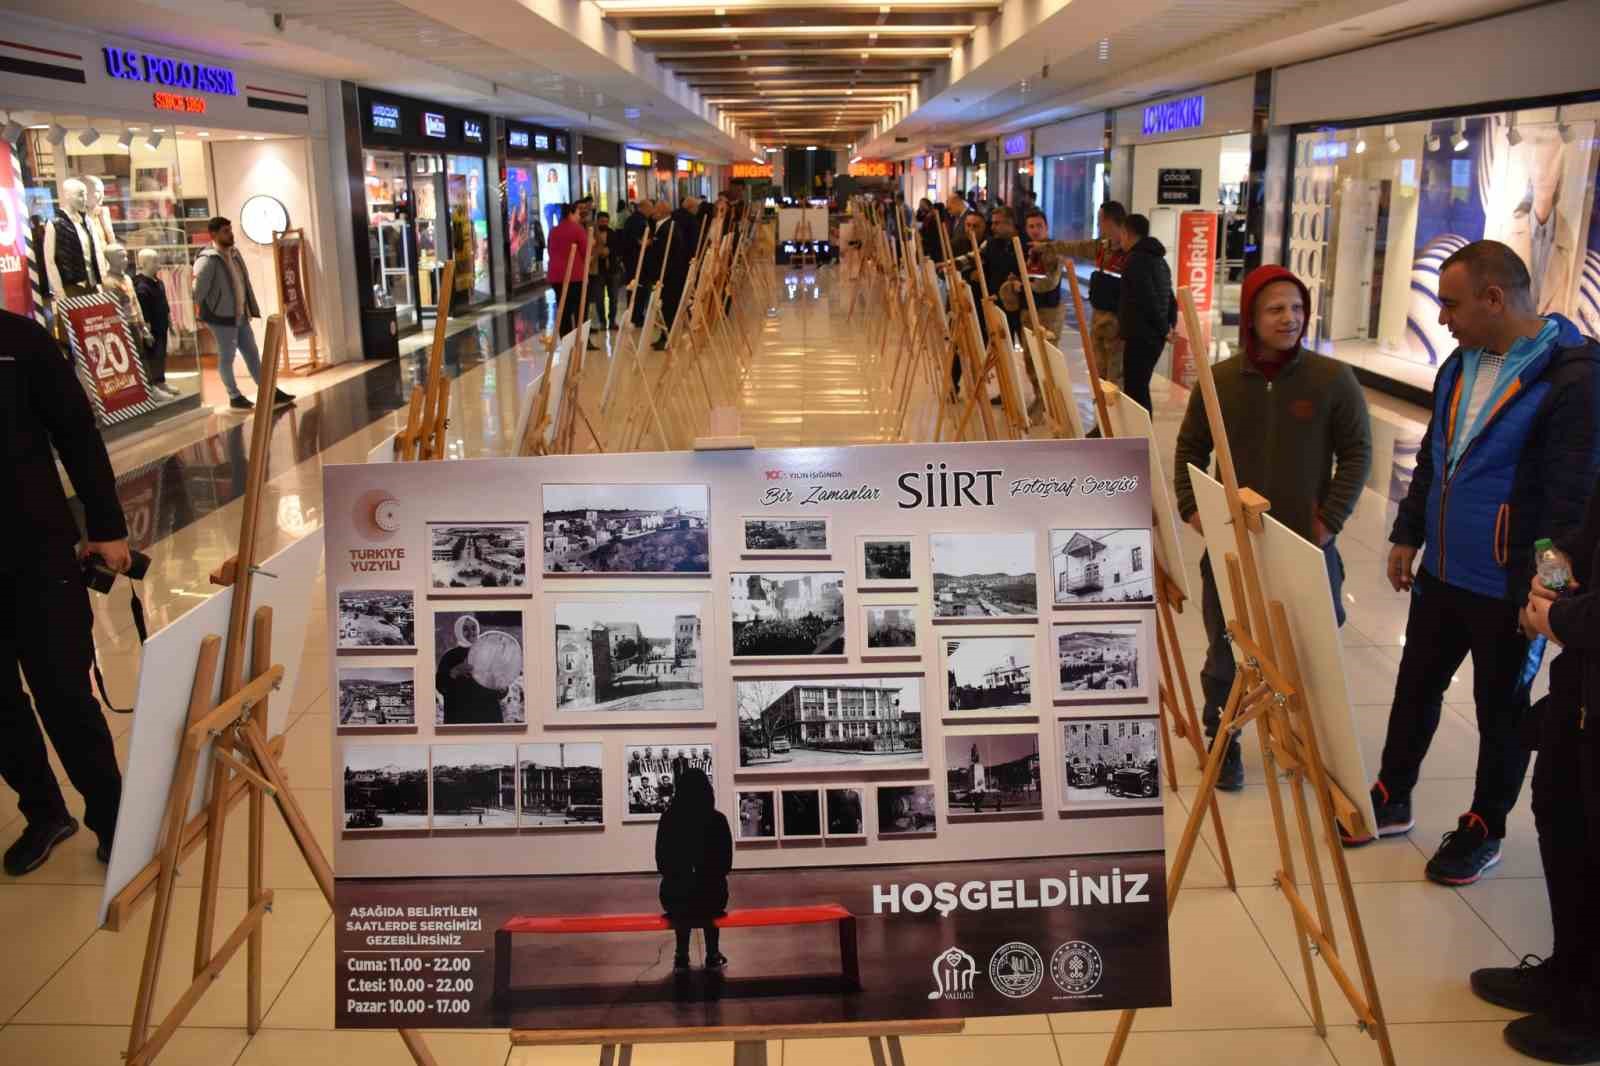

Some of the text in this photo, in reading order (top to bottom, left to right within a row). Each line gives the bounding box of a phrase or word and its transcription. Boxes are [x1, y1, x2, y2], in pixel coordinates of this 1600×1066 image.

[103, 47, 239, 96] U.S. POLO ASSN.
[84, 332, 129, 379] 20
[760, 463, 1138, 509] Bir Zamanlar SİİRT Fotoğraf Sergisi
[872, 867, 1150, 918] HOŞGELDİNİZ
[350, 904, 477, 919] AŞAĞIDA BELİRTİLEN
[346, 919, 482, 932] SAATLERDE SERGİMİZİ
[366, 933, 461, 946] GEZEBİLİRSİNİZ
[347, 958, 387, 972] Cuma:
[389, 958, 422, 972] 11.00
[433, 958, 471, 971] 22.00
[347, 978, 387, 992] C.tesi:
[389, 979, 424, 992] 10.00
[436, 979, 474, 992] 22.00
[347, 999, 387, 1013] Pazar:
[389, 1000, 425, 1013] 10.00
[436, 1000, 471, 1013] 17.00
